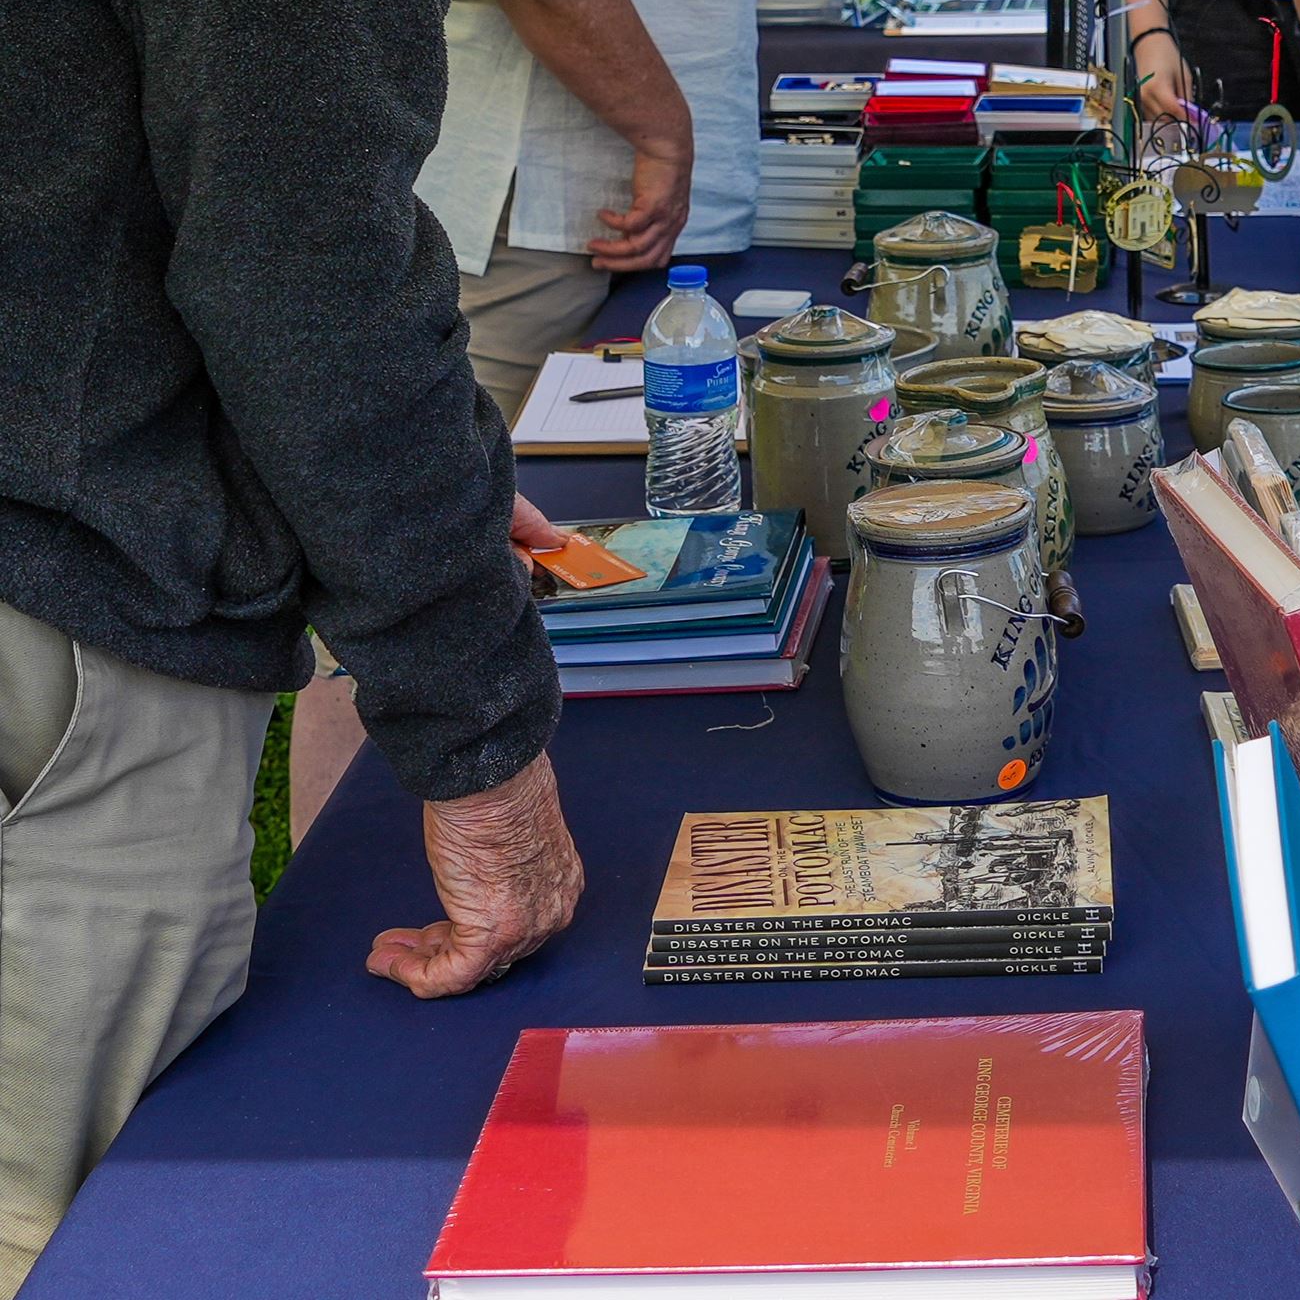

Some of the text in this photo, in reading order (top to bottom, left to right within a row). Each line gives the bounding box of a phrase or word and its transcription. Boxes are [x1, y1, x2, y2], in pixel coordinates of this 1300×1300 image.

[964, 290, 994, 341] KING
[1119, 445, 1154, 502] KING
[1043, 476, 1060, 544] KING
[727, 513, 764, 536] King
[990, 593, 1034, 672] KING
[835, 821, 848, 837] THE
[1085, 822, 1094, 845] OICKLE
[838, 838, 849, 849] OF
[691, 817, 775, 912] DISASTER
[777, 850, 788, 878] ON THE
[789, 814, 836, 908] POTOMAC
[840, 849, 852, 865] RUN
[851, 815, 876, 902] STEAMBOAT WAWASET
[1087, 853, 1095, 873] ALVIN
[844, 884, 857, 899] THE
[674, 916, 912, 933] DISASTER ON THE POTOMAC
[1017, 912, 1070, 922] OICKLE
[670, 934, 908, 950] DISASTER ON THE POTOMAC
[1012, 930, 1065, 940] OICKLE
[668, 949, 905, 964] DISASTER ON THE POTOMAC
[1009, 945, 1062, 955] OICKLE
[663, 967, 901, 982] DISASTER ON THE POTOMAC
[1005, 964, 1058, 973] OICKLE
[883, 1103, 905, 1168] Church Cemeteries
[906, 1119, 921, 1146] Volume
[963, 1057, 993, 1215] KING GEORGE COUNTY, VIRGINIA
[992, 1096, 1012, 1170] CEMETERIES OF
